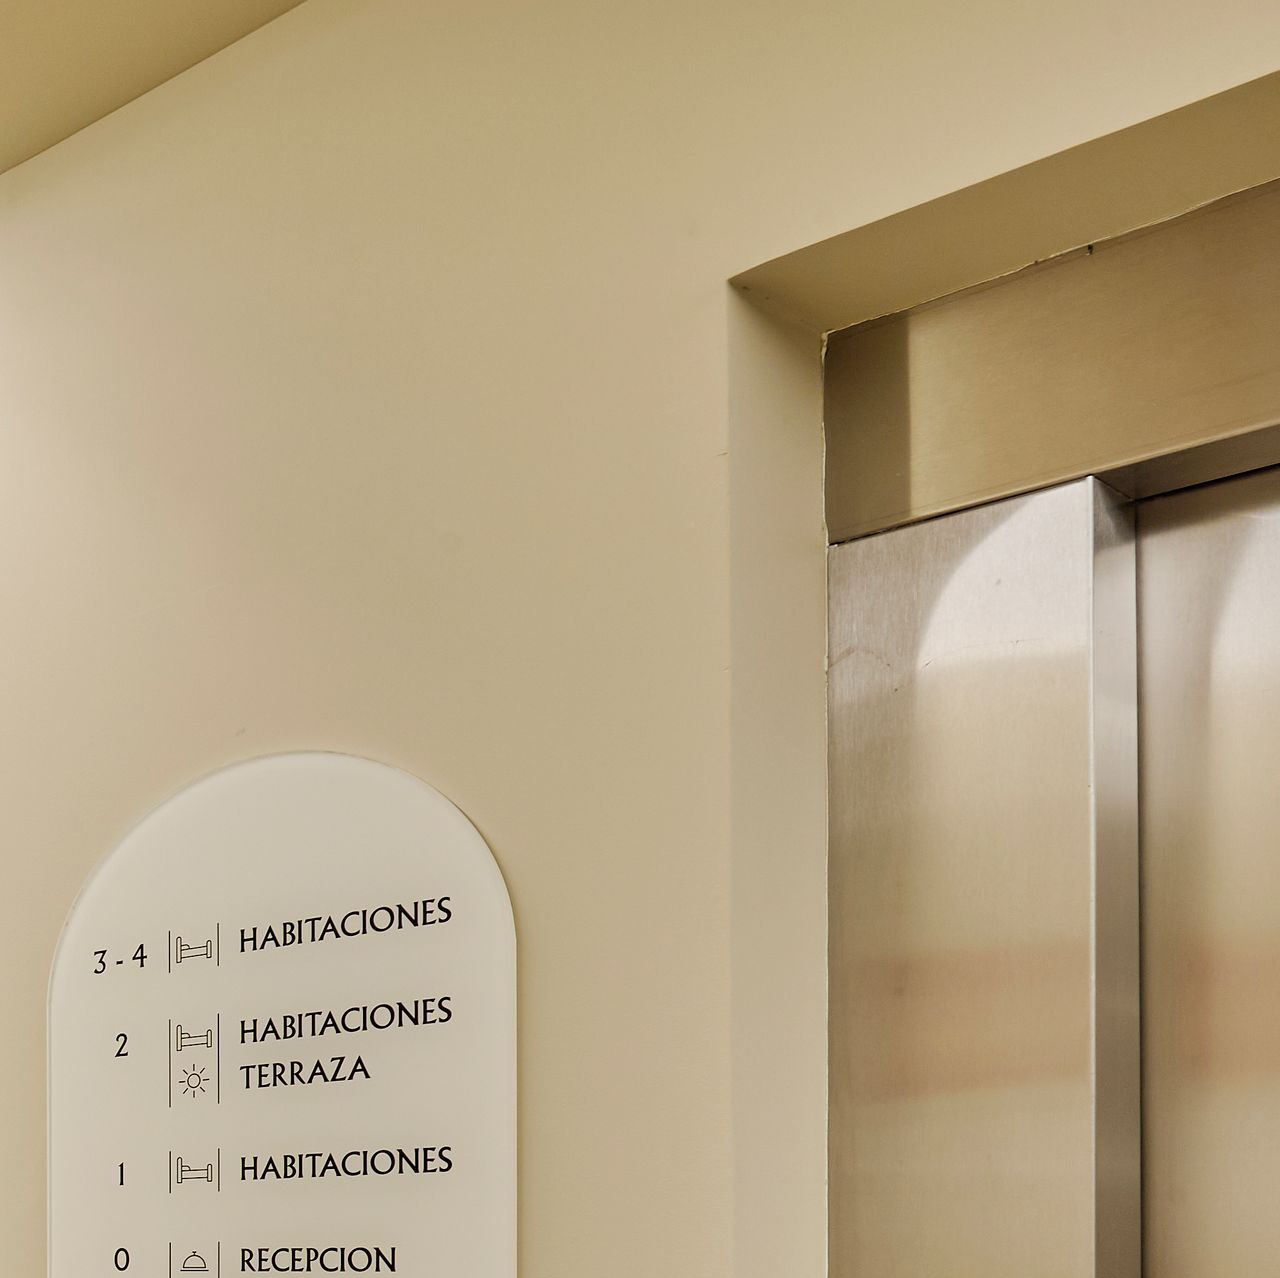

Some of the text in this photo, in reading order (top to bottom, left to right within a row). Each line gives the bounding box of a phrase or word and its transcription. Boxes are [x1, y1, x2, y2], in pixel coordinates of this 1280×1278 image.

[93, 949, 109, 975] 3
[131, 943, 148, 969] 4
[239, 896, 453, 953] HABITACIONES
[114, 996, 453, 1059] 2 HABITACIONES
[239, 1055, 372, 1090] TERRAZA
[117, 1146, 453, 1187] 1 HABITACIONES
[113, 1246, 397, 1273] 0 RECEPCION
